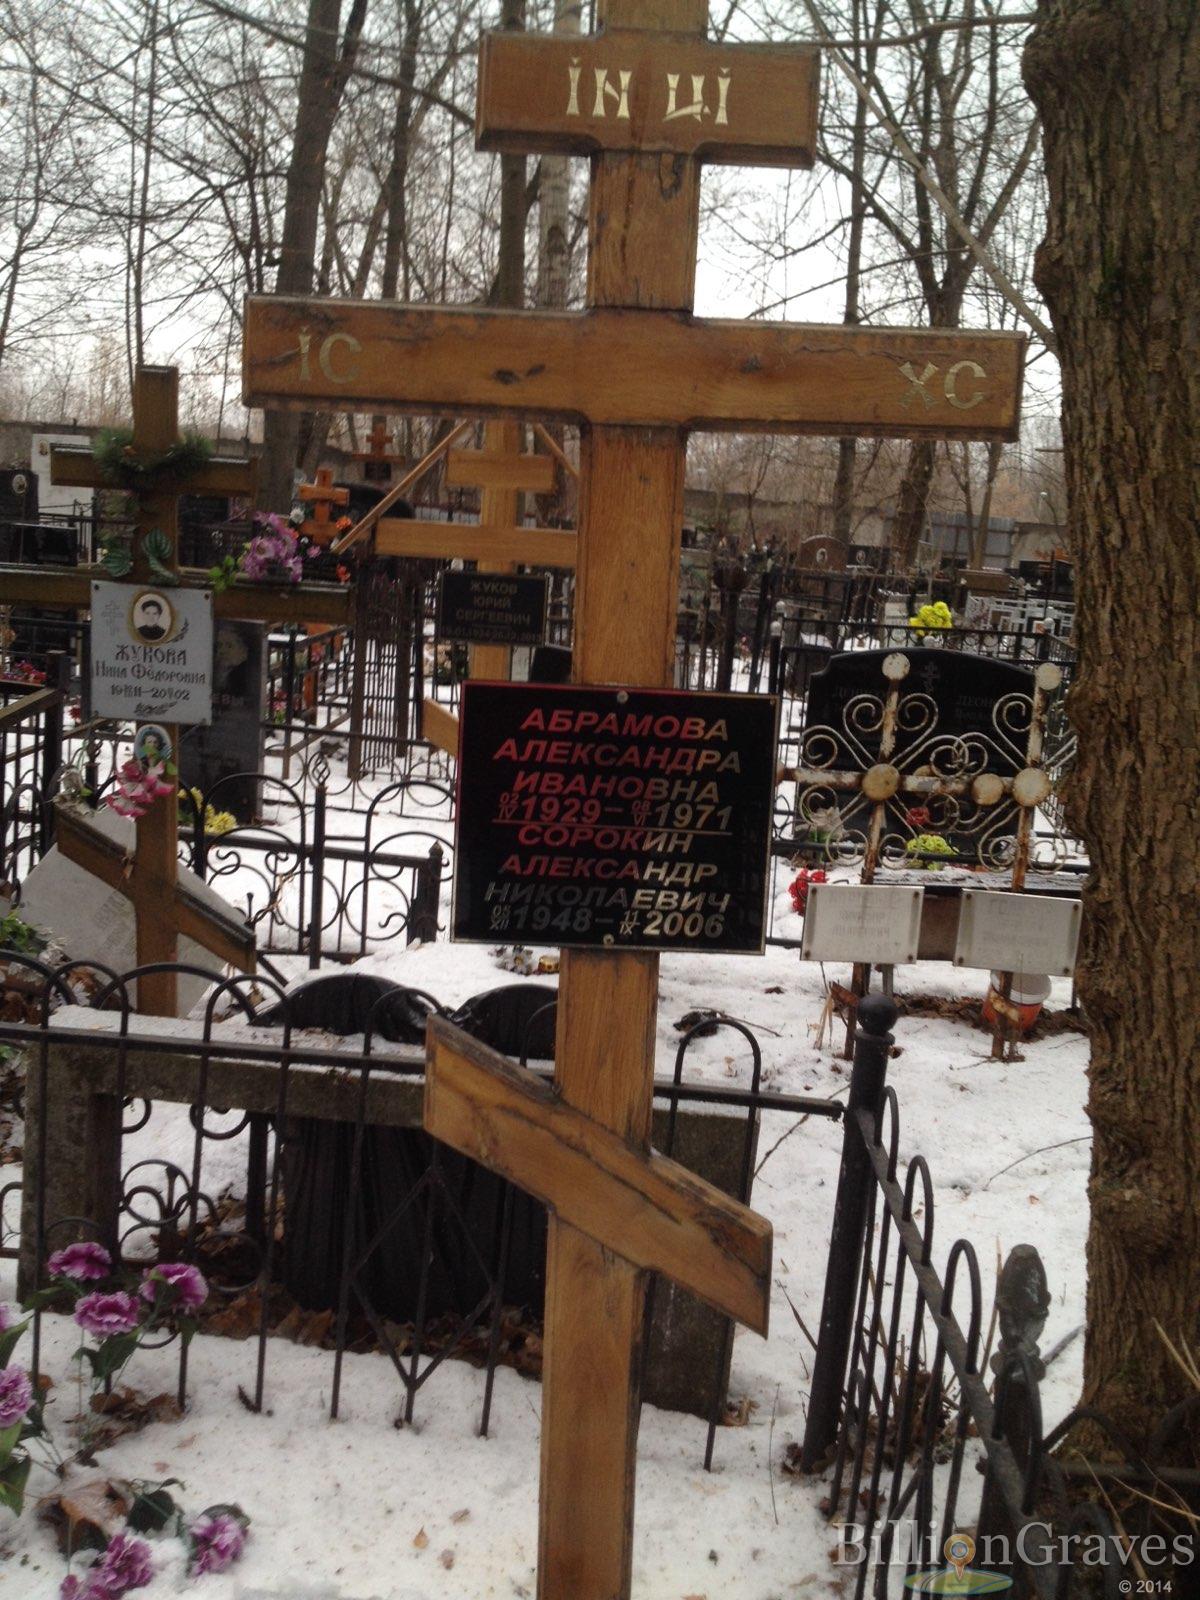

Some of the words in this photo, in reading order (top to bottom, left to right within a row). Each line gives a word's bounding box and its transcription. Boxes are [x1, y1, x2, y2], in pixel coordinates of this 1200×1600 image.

[470, 580, 518, 595] ЖУКОВ
[473, 595, 512, 608] ЮРИЙ
[115, 643, 187, 666] ЖУКОВА
[520, 708, 729, 741] АБРАМОВА
[494, 738, 741, 775] АЛЕКСАНДРА
[512, 770, 720, 803] ИВАНОВНА
[522, 797, 600, 825] 1929
[655, 801, 732, 831] 1971
[518, 824, 694, 854] СОРОКИН
[501, 854, 718, 887] АЛЕКСАНДР
[484, 881, 731, 913] НИКОЛАЕВИЧ
[513, 905, 592, 932] 1948
[643, 910, 725, 938] 2006
